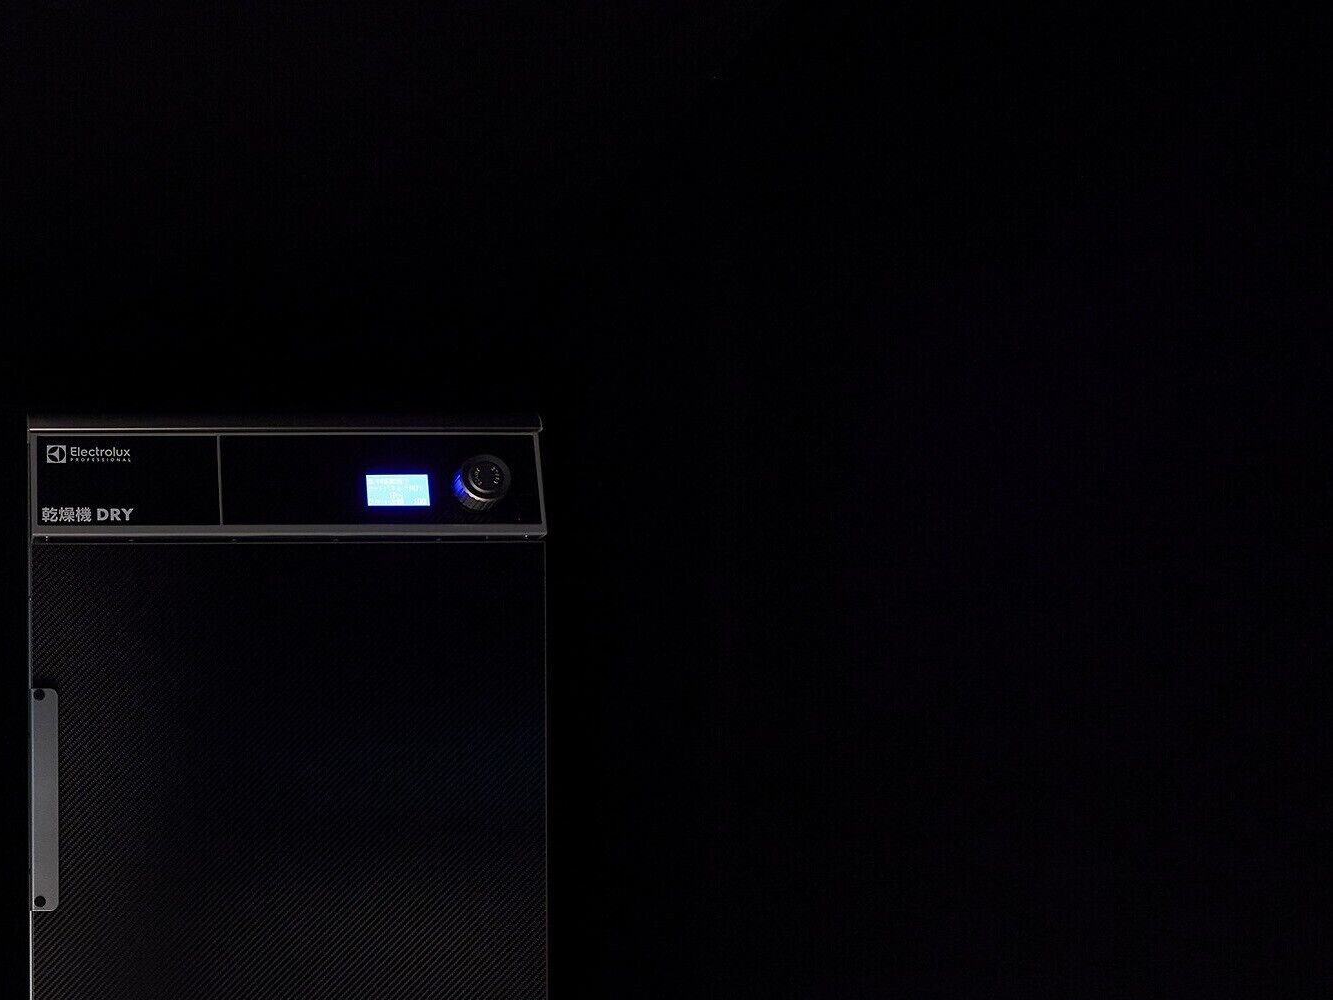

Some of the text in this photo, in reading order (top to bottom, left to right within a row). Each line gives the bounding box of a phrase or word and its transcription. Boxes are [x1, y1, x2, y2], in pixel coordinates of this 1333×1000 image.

[70, 446, 131, 457] Electrolux
[41, 507, 134, 522] 乾燥機 DRY
